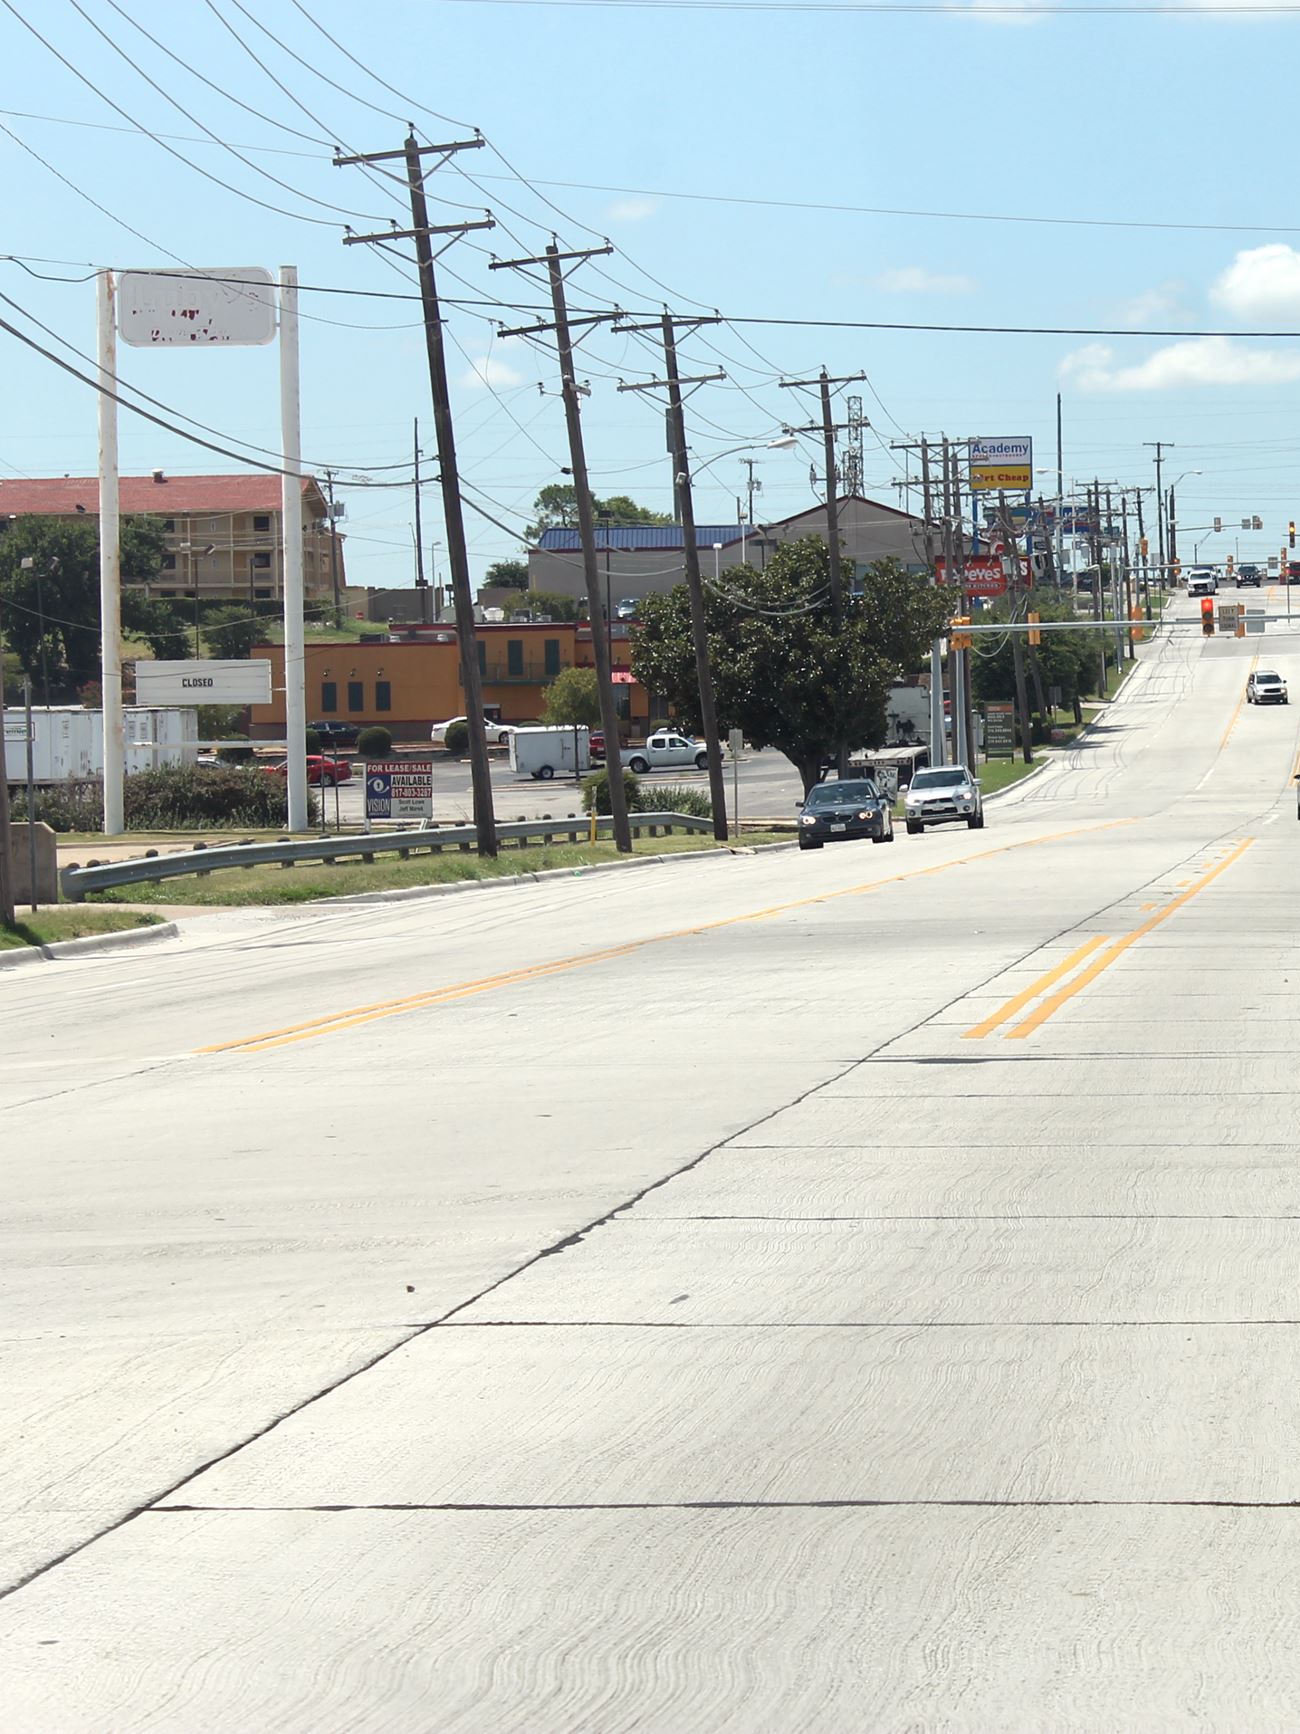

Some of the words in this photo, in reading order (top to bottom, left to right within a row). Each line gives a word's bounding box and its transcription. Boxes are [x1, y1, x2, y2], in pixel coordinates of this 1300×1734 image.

[972, 443, 1029, 456] Academy
[182, 678, 214, 688] CLOSED
[367, 764, 383, 772] FOR
[384, 764, 431, 772] LEASE/SALE
[392, 776, 431, 785] AVAILABLE
[368, 799, 391, 812] VISION
